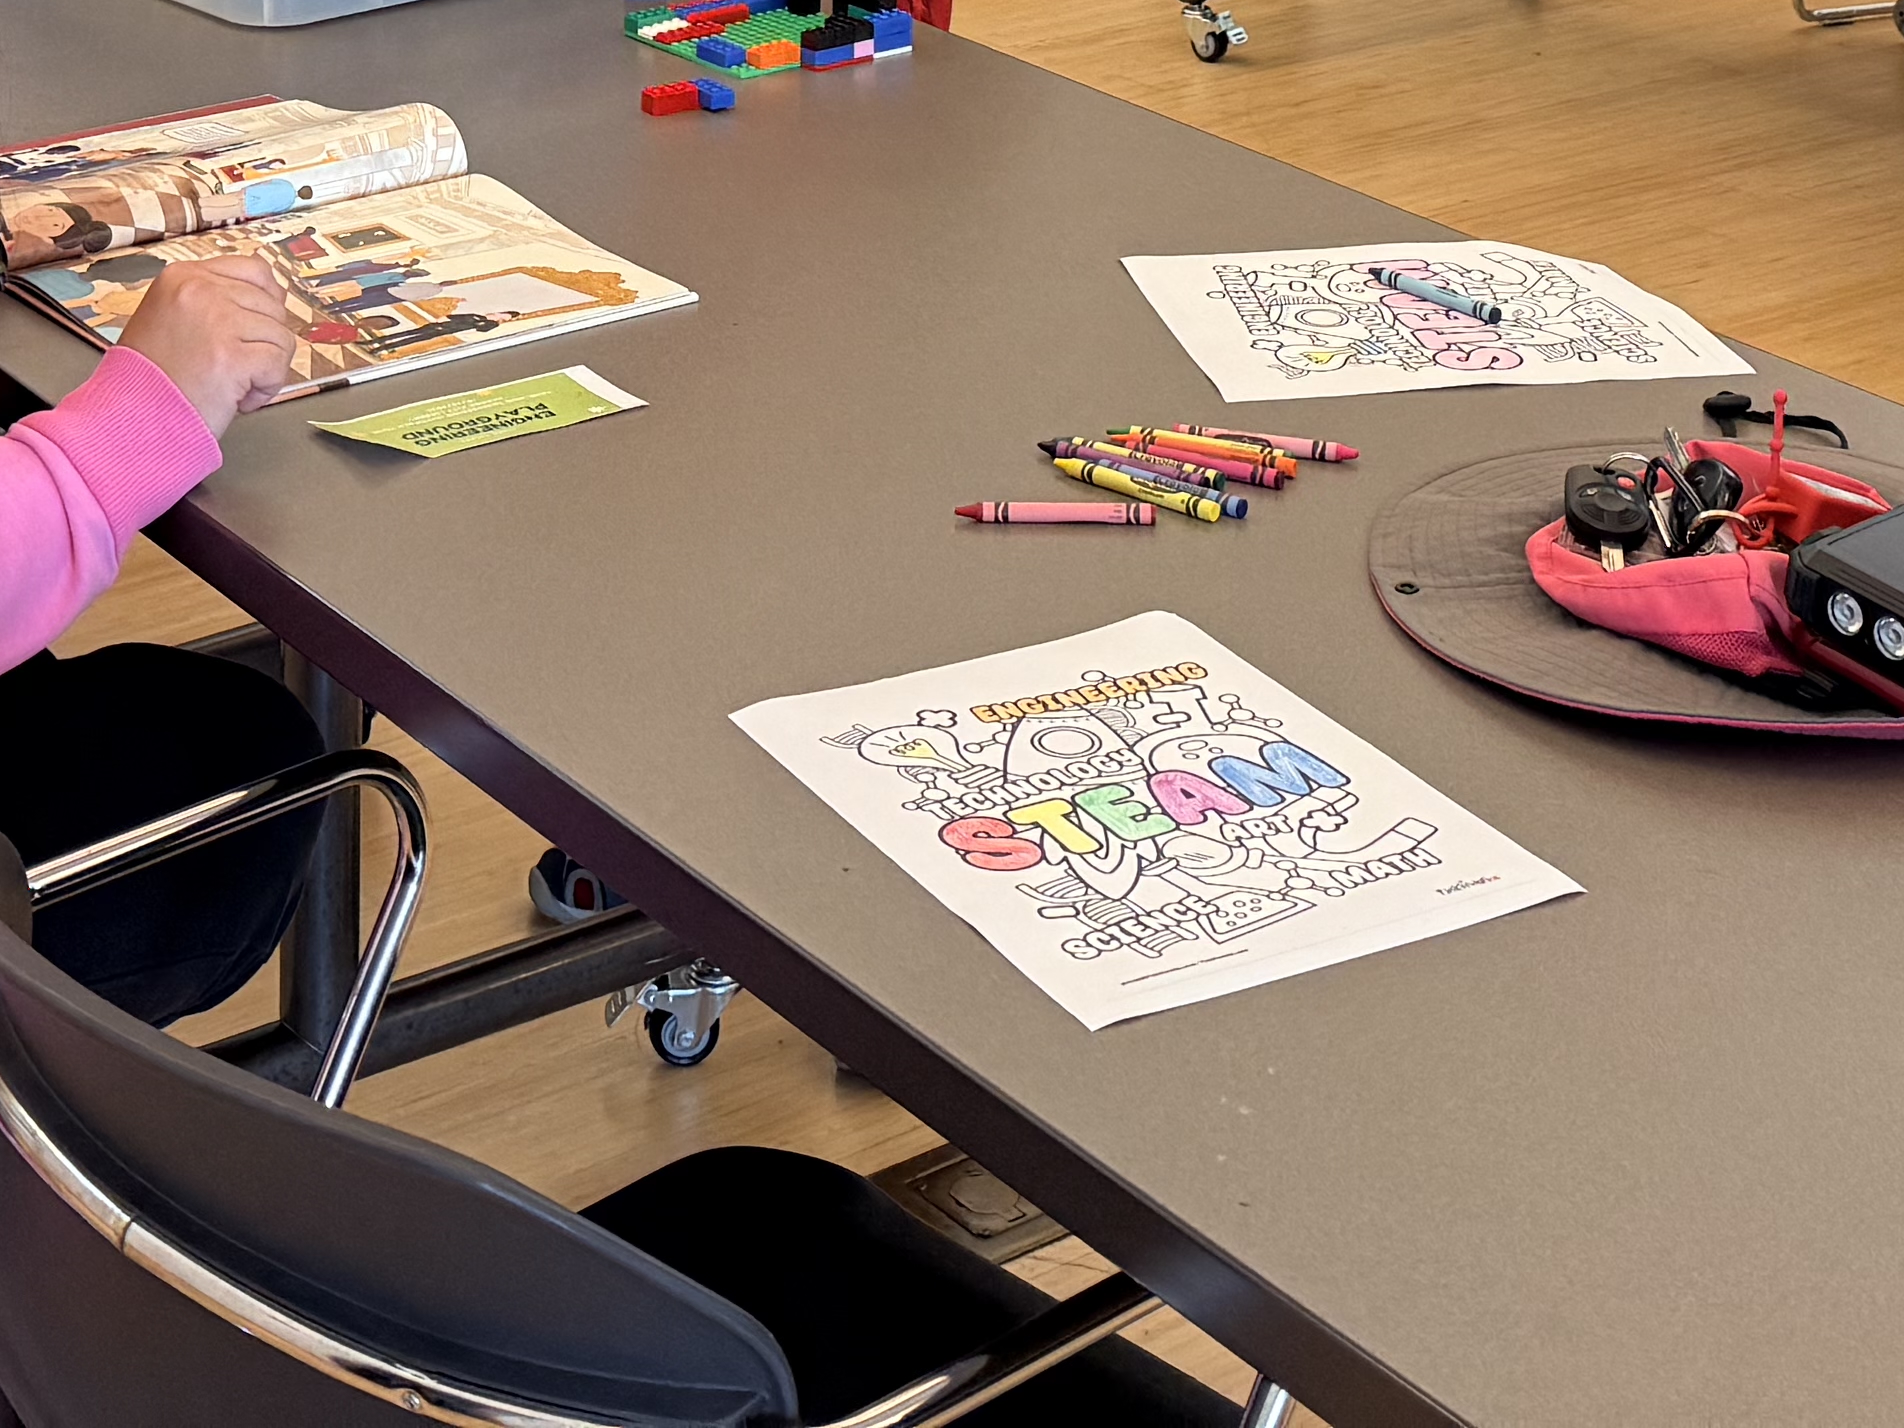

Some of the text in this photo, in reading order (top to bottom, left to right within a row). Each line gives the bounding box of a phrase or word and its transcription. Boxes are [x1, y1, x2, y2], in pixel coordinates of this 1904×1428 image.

[401, 402, 549, 440] PLAYGROUND
[415, 411, 556, 447] ENGINEERING
[970, 661, 1208, 726] ENGINEERING
[922, 745, 1146, 821] TECHNOLOGY
[938, 739, 1353, 872] STEAM
[1220, 813, 1294, 846] ART
[1328, 843, 1443, 894] MATH
[1060, 890, 1221, 961] SCIENCE
